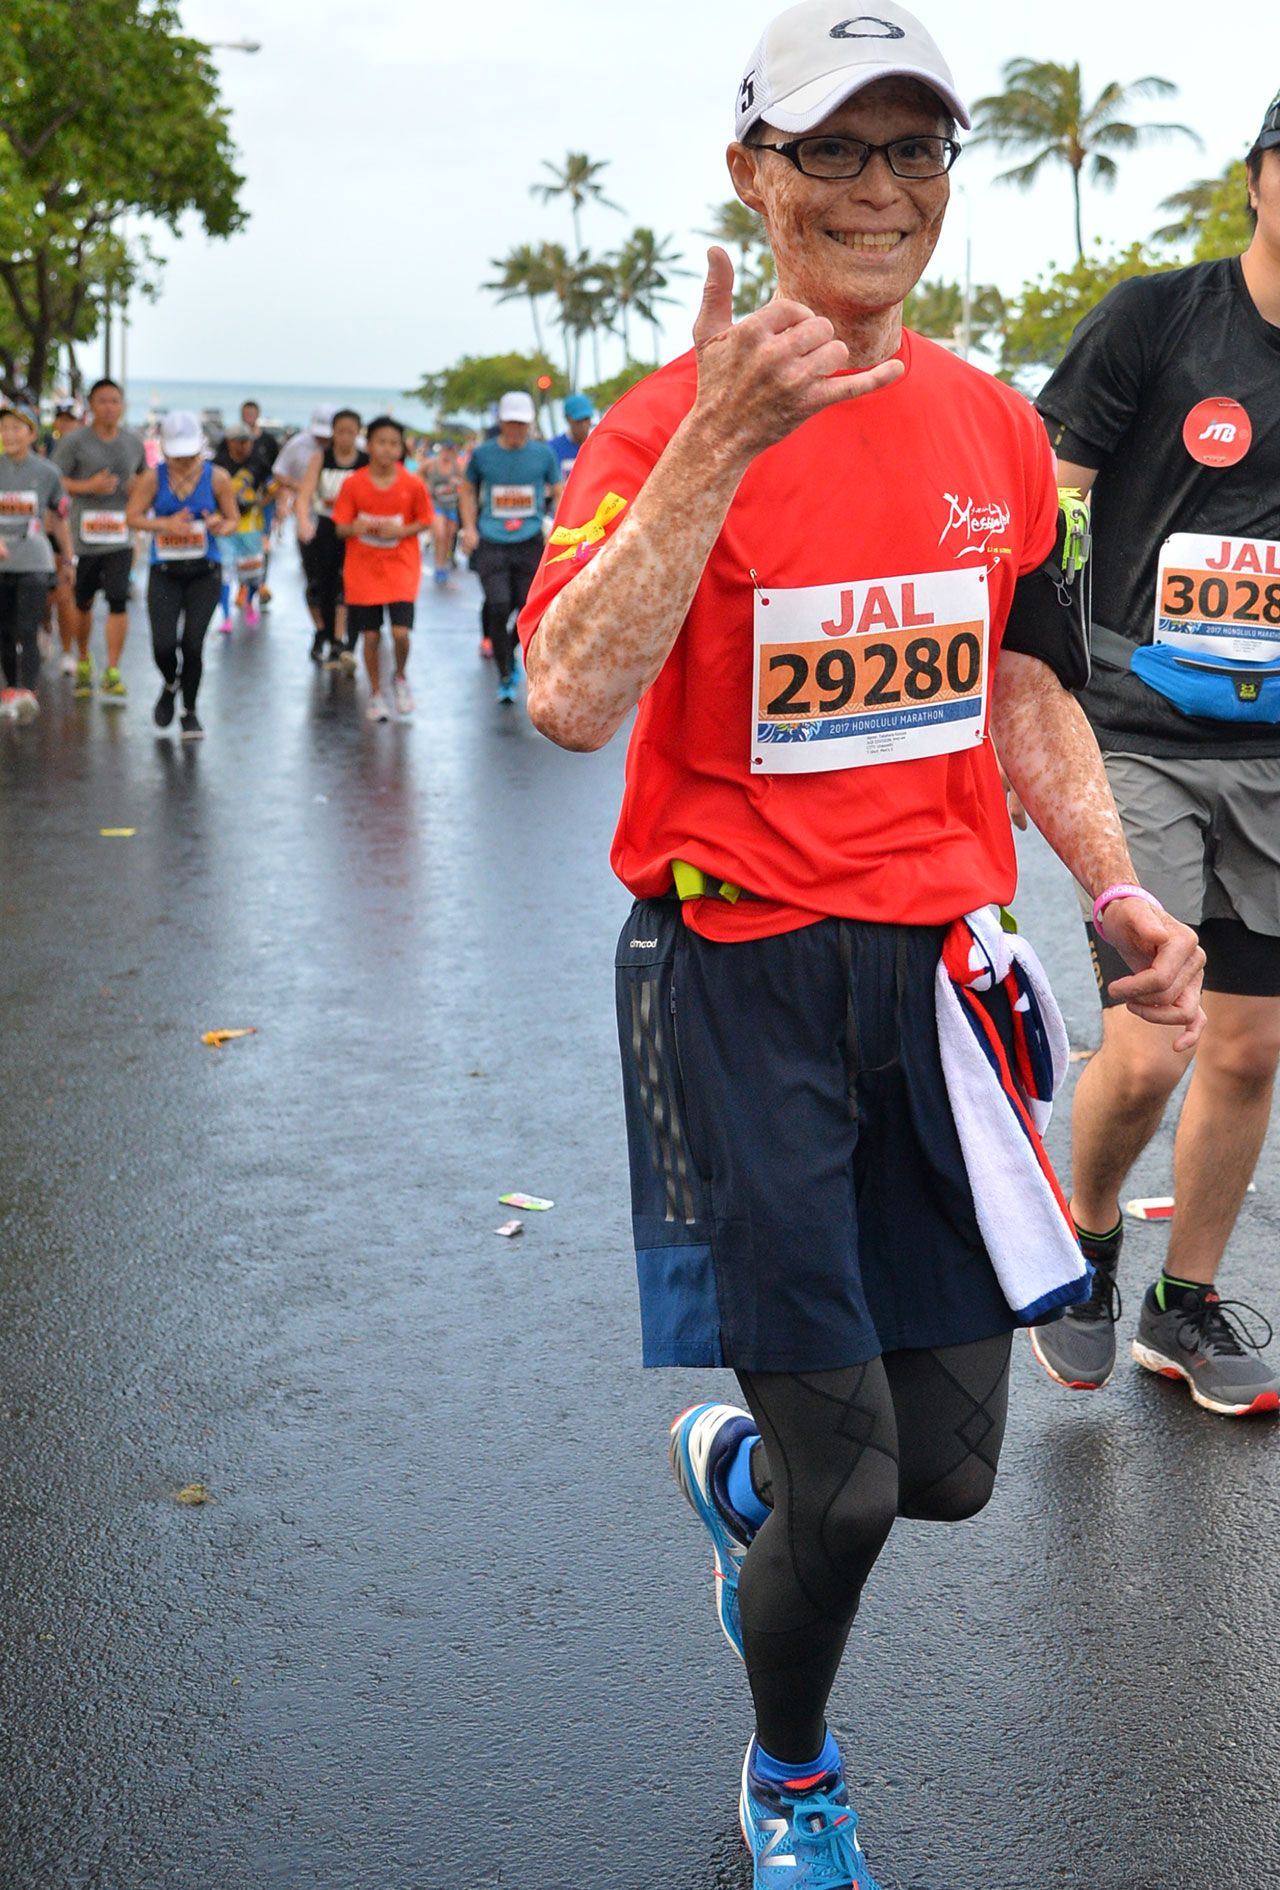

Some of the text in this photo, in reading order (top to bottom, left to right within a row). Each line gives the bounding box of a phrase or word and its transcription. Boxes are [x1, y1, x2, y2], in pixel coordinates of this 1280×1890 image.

[1198, 422, 1237, 443] JTB
[1205, 541, 1280, 575] JAL
[821, 582, 934, 637] JAL
[1206, 625, 1222, 635] 2017
[1222, 627, 1257, 637] HONOLULU
[767, 632, 980, 715] 29280
[829, 709, 945, 734] 2017 HONOLULU MARATHON
